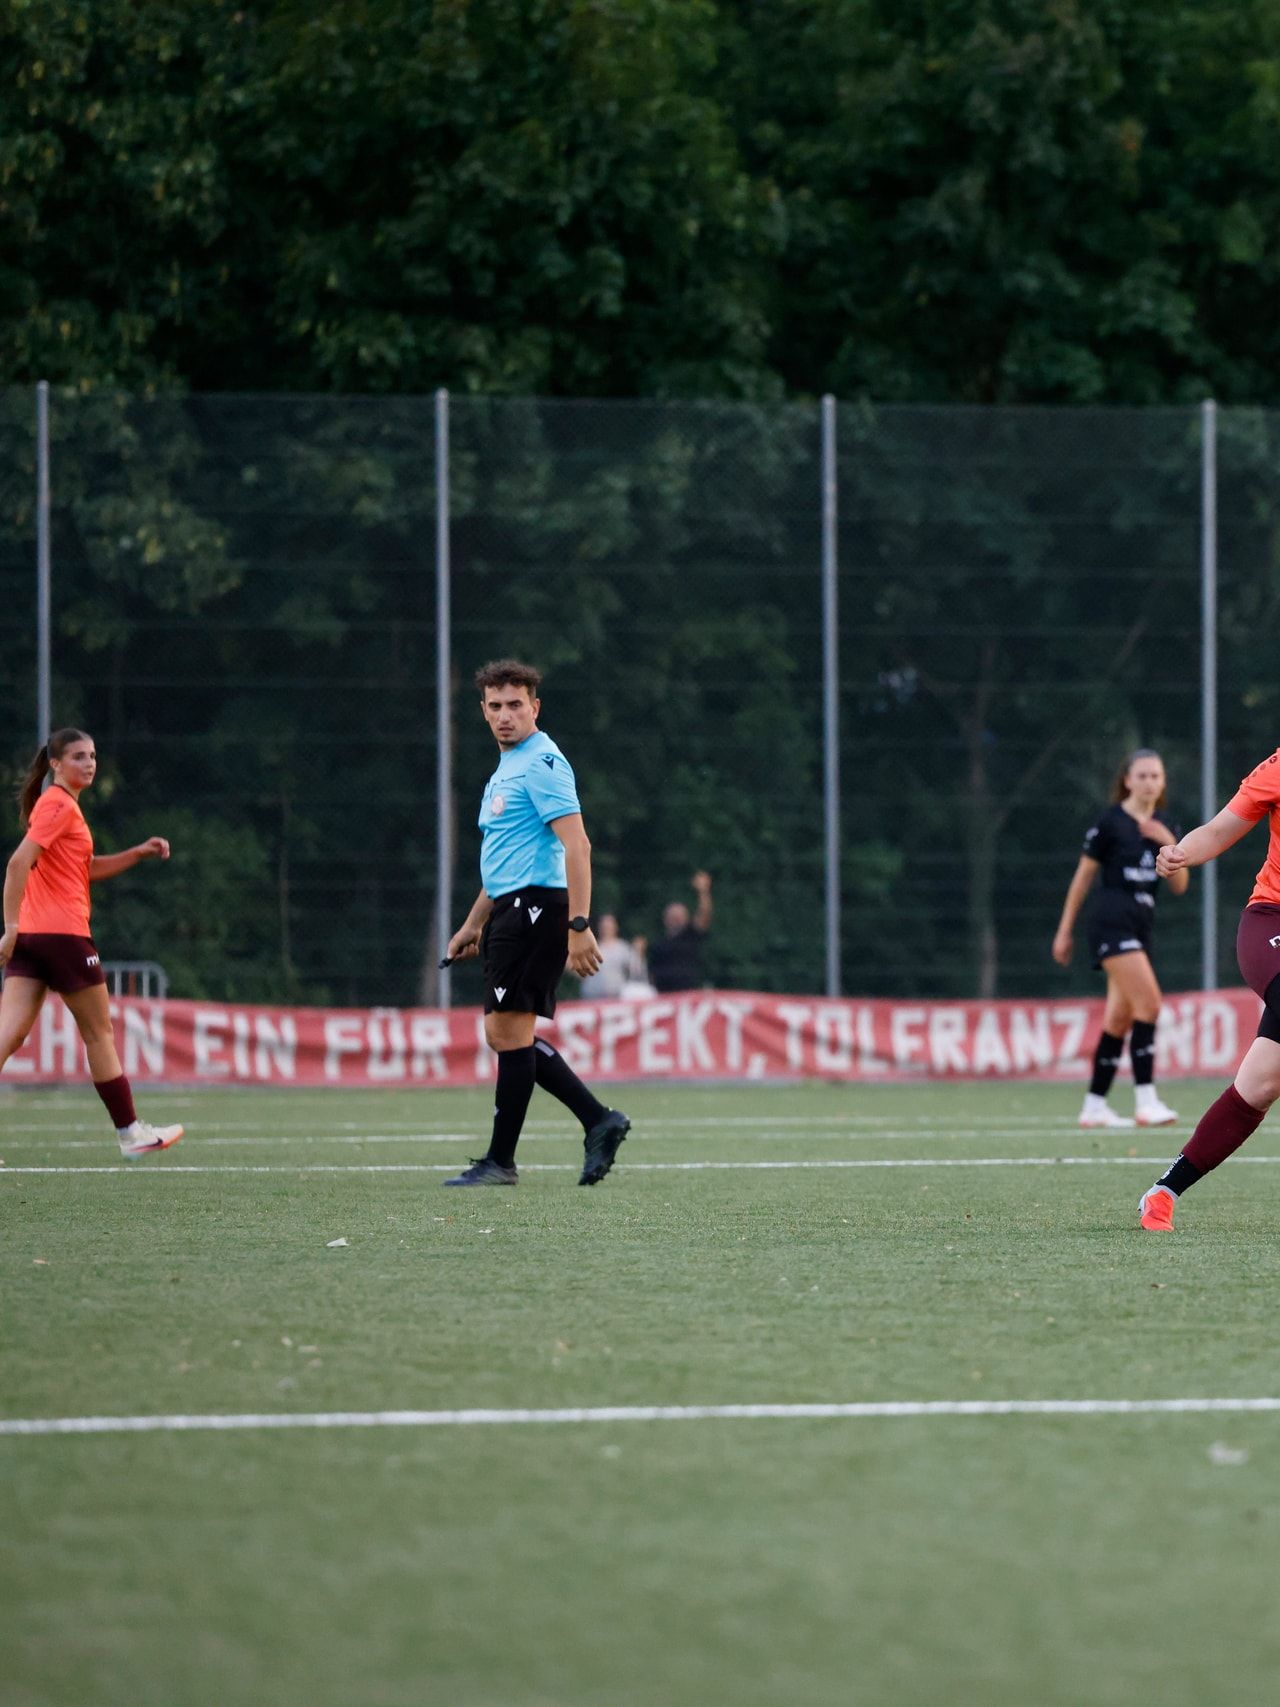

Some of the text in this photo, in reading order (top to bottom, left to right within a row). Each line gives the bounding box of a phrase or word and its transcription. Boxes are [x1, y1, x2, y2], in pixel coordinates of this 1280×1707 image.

[193, 1010, 299, 1079] EIN
[323, 1005, 450, 1081] FÜR
[777, 1003, 1088, 1073] TOLERANZ
[1118, 1000, 1238, 1070] ND
